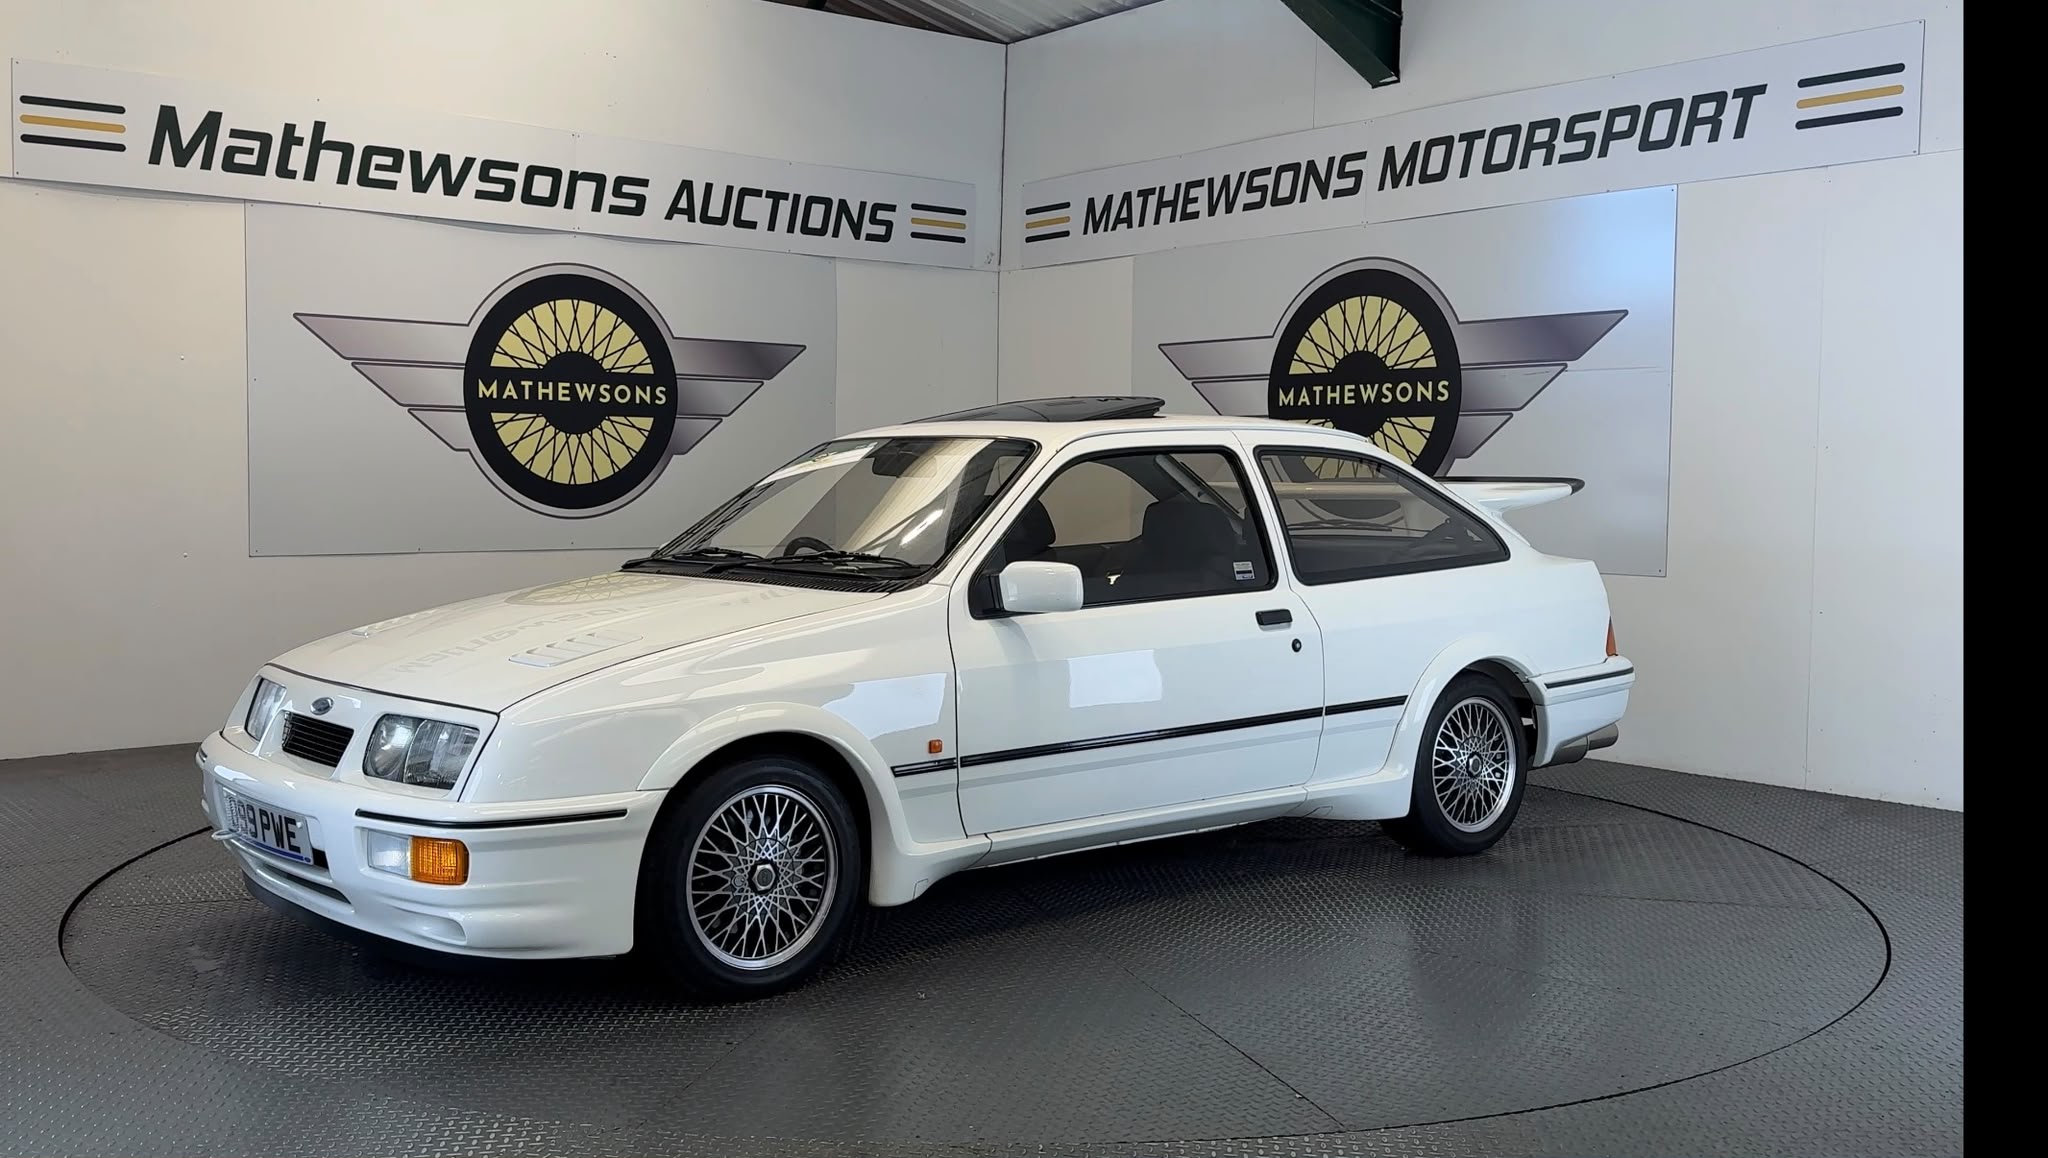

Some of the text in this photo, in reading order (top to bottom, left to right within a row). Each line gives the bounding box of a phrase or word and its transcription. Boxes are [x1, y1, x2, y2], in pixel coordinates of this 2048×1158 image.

[148, 104, 899, 245] Mathewsons AUCTIONS
[1082, 83, 1769, 237] MATHEWSONS MOTORSPORT
[477, 378, 668, 406] MATHEWSONS
[1278, 380, 1451, 408] MATHEWSONS
[258, 807, 301, 854] PWE
